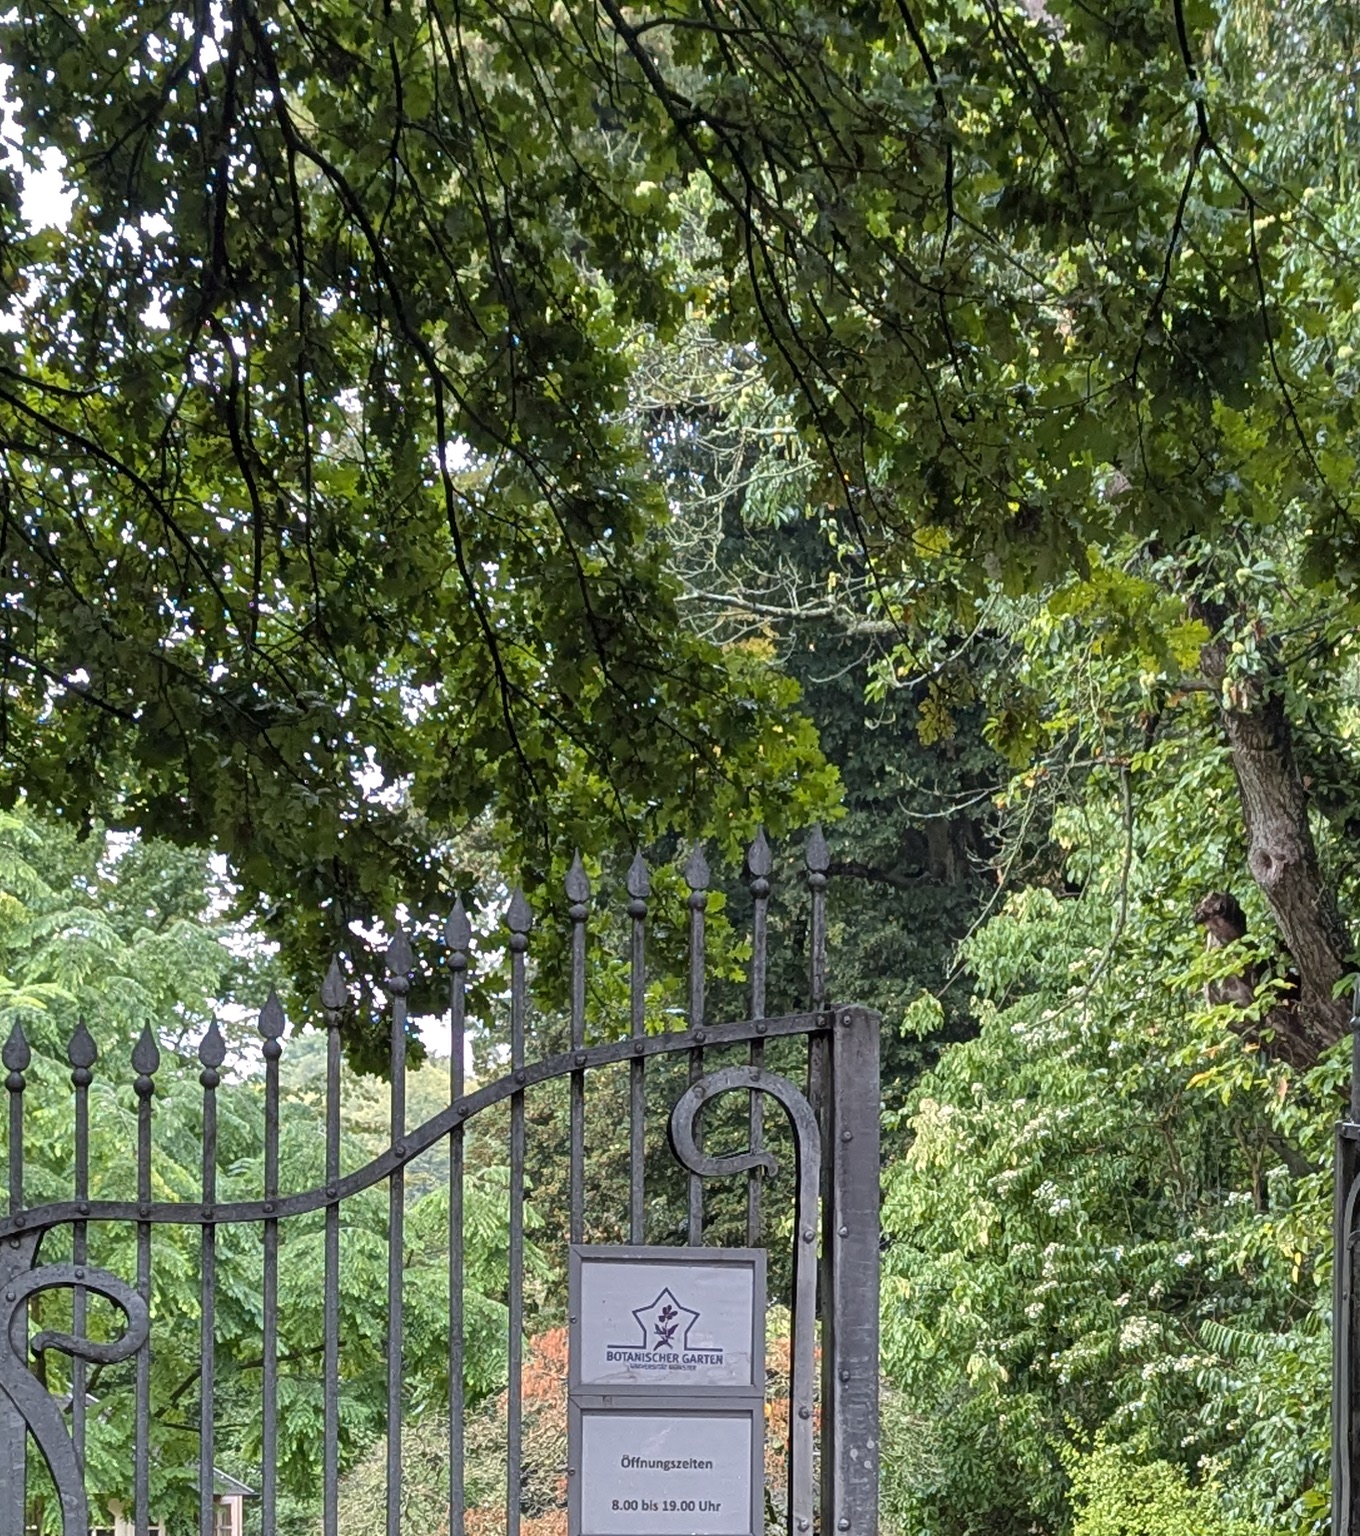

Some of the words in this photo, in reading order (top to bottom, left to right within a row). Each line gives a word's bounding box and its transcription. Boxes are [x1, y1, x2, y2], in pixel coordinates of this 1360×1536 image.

[606, 1351, 679, 1364] BOTANISCHER
[682, 1354, 723, 1365] GARTEN
[621, 1454, 713, 1471] Öffnungszeiten
[611, 1499, 638, 1511] 8.00
[641, 1499, 659, 1511] bis
[662, 1500, 696, 1512] 19.00
[699, 1500, 721, 1512] Uhr
